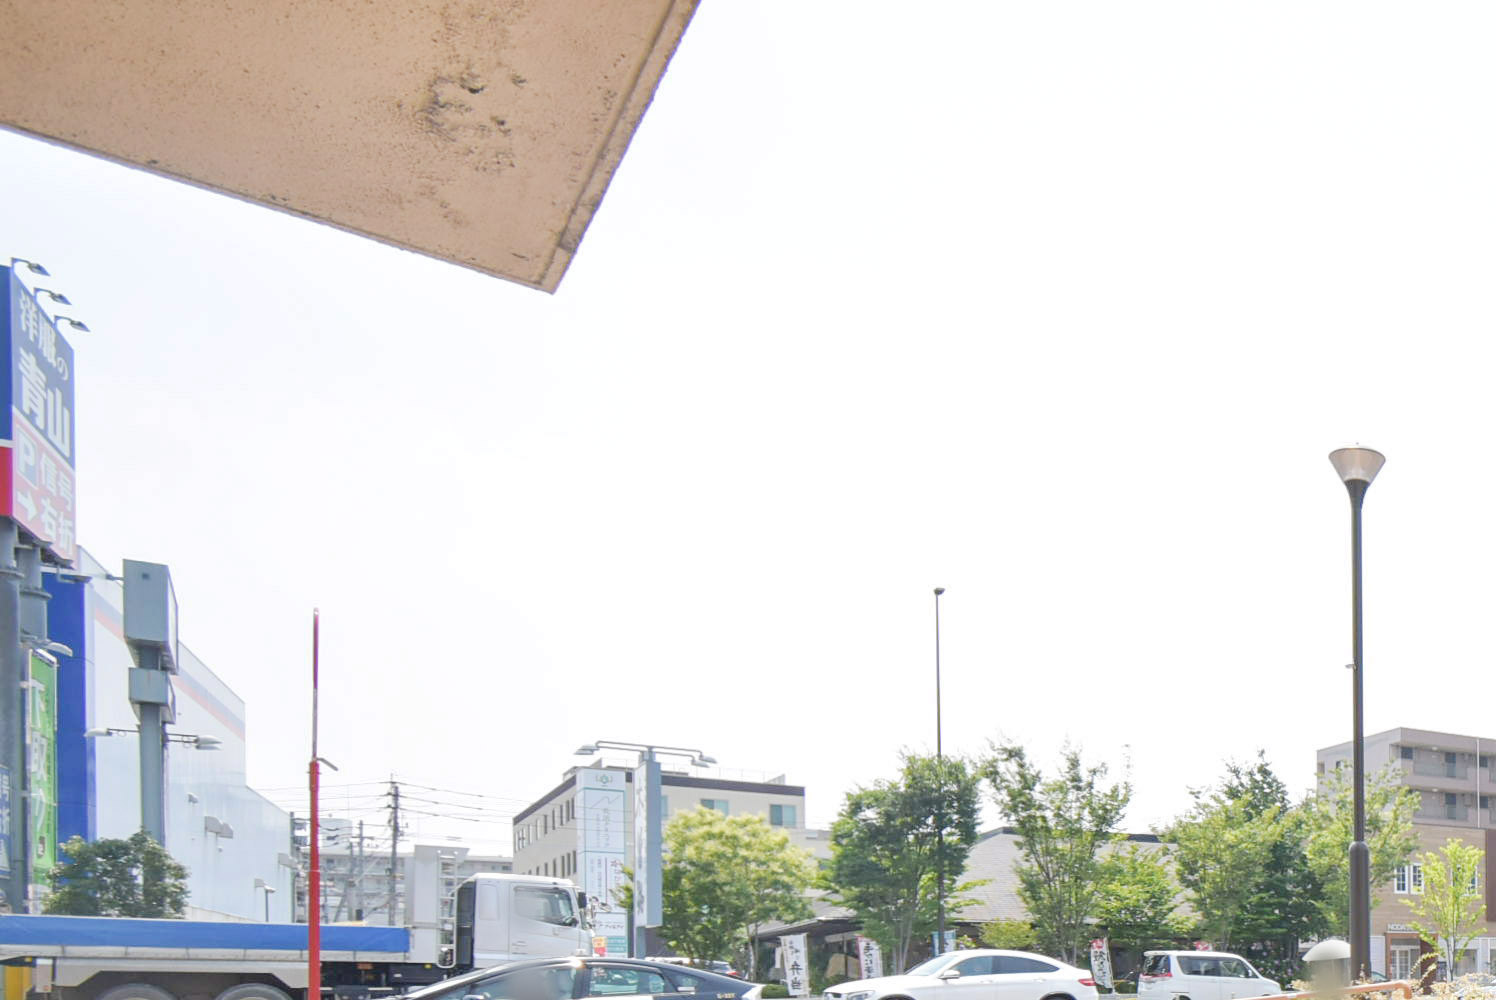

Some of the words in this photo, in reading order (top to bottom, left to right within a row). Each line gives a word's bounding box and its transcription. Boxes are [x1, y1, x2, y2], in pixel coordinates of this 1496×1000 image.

[18, 289, 69, 382] 洋服の
[18, 346, 71, 458] 青山
[39, 452, 72, 513] 信号
[40, 496, 73, 557] 右折
